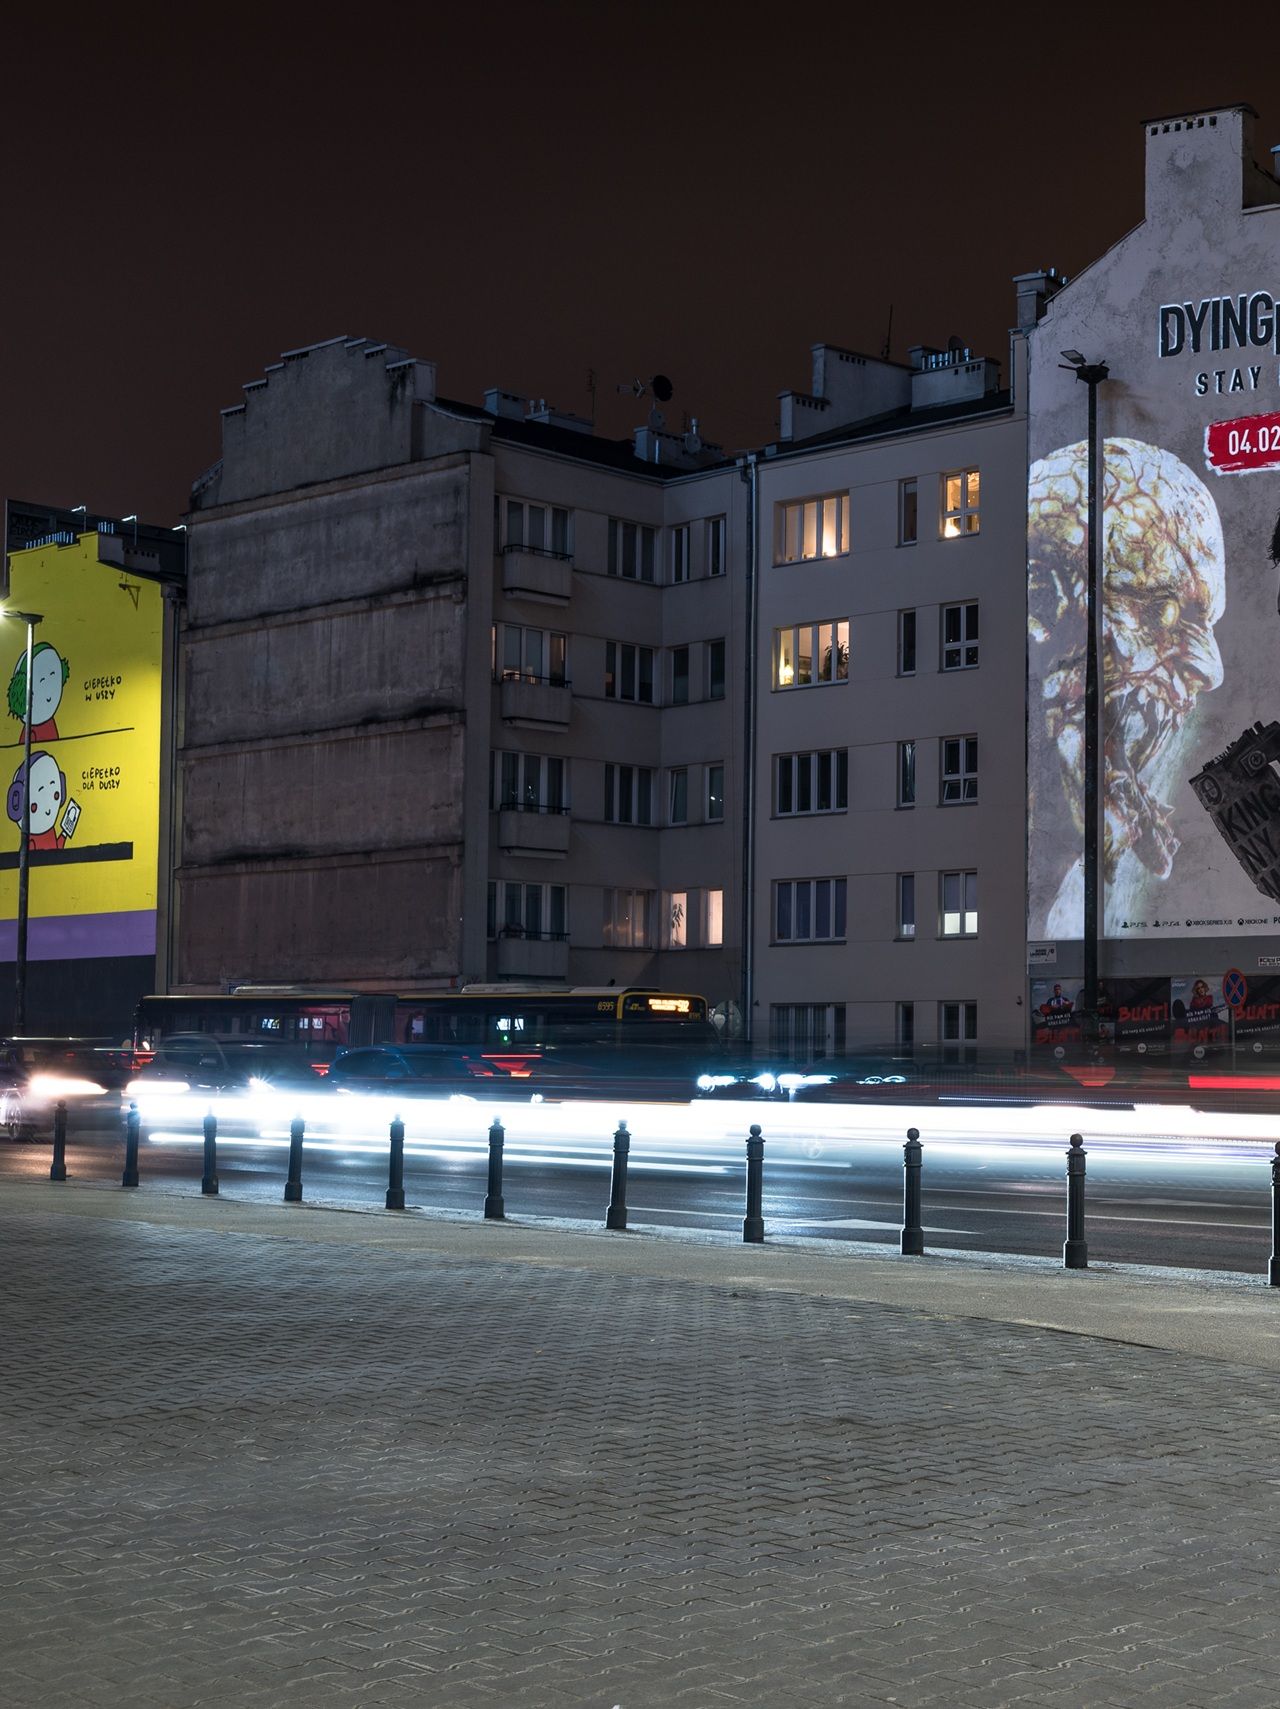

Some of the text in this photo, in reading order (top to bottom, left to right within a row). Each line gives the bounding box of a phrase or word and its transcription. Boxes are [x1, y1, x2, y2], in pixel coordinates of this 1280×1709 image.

[1195, 366, 1262, 396] STAY
[85, 689, 116, 701] W USZY
[82, 778, 121, 790] DLA DUSZY
[1117, 1002, 1169, 1022] BUNT!
